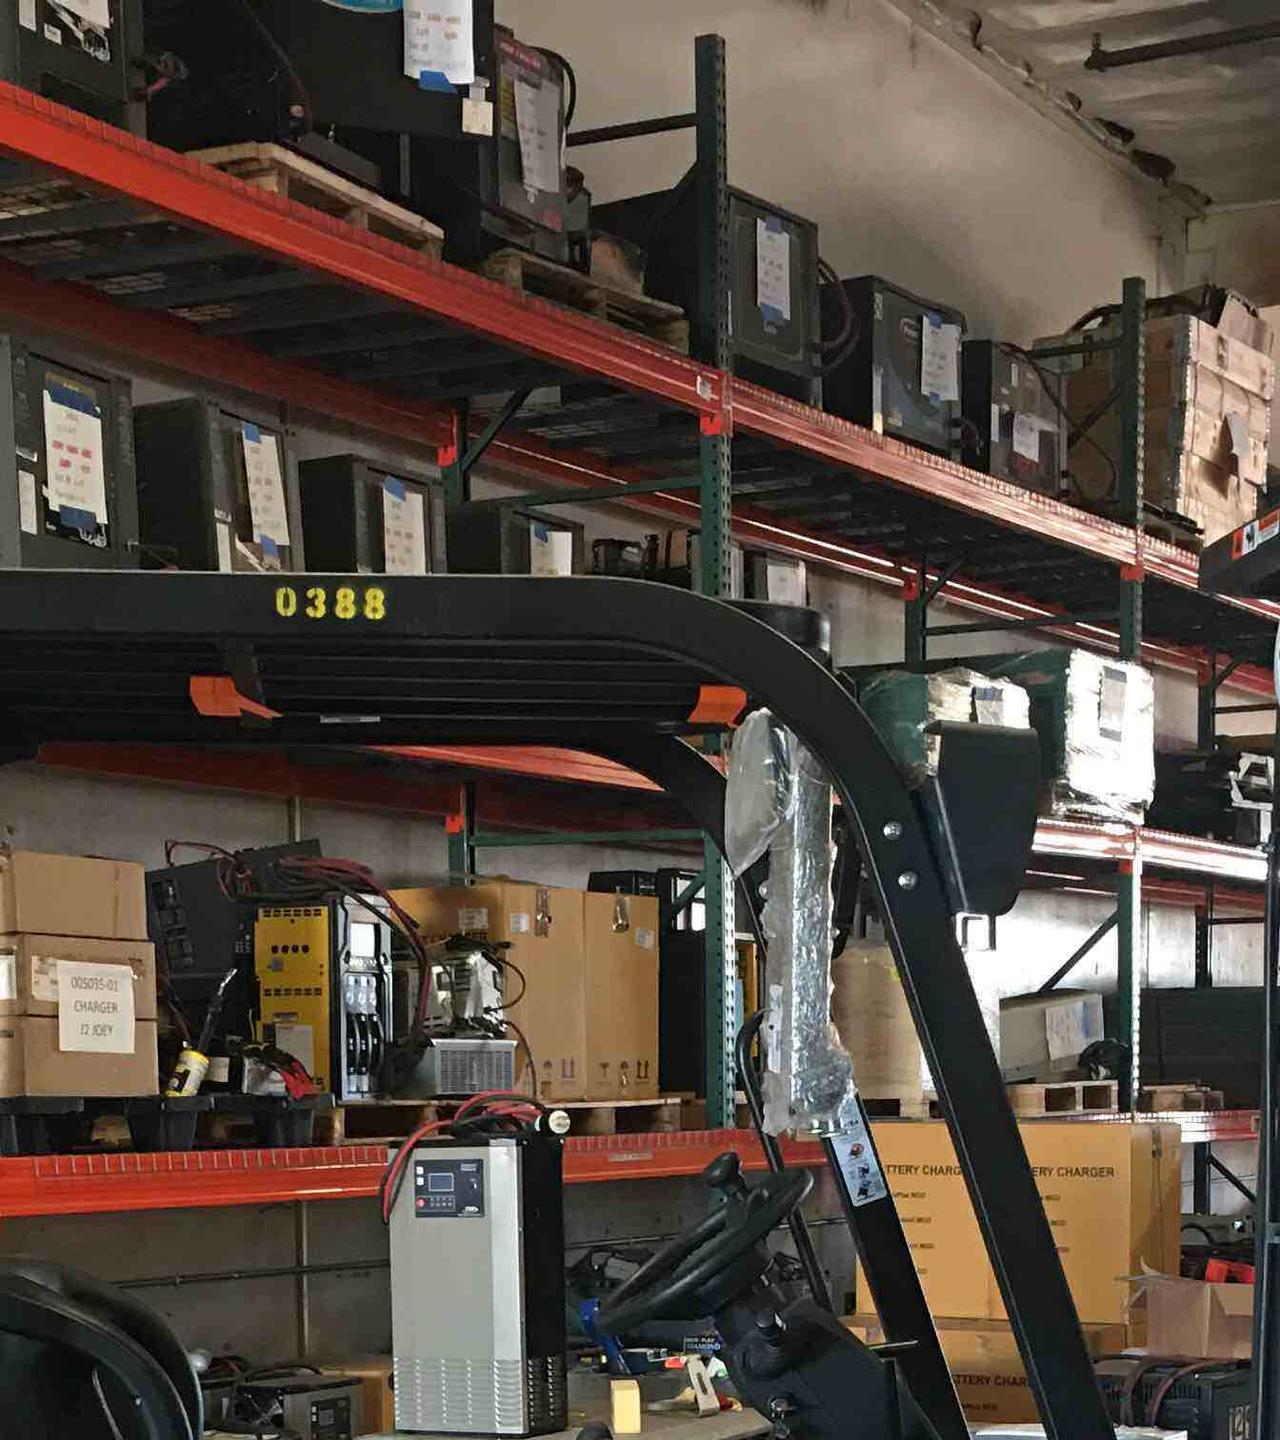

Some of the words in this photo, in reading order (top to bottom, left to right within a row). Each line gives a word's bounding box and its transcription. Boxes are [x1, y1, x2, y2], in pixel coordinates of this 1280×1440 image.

[276, 587, 385, 619] 0388
[74, 999, 119, 1014] CHARGER
[884, 1164, 920, 1175] TTERY
[922, 1165, 961, 1176] CHARG
[1057, 1166, 1115, 1178] CHARGER
[955, 1374, 991, 1386] TTERY
[994, 1375, 1027, 1387] CHAR
